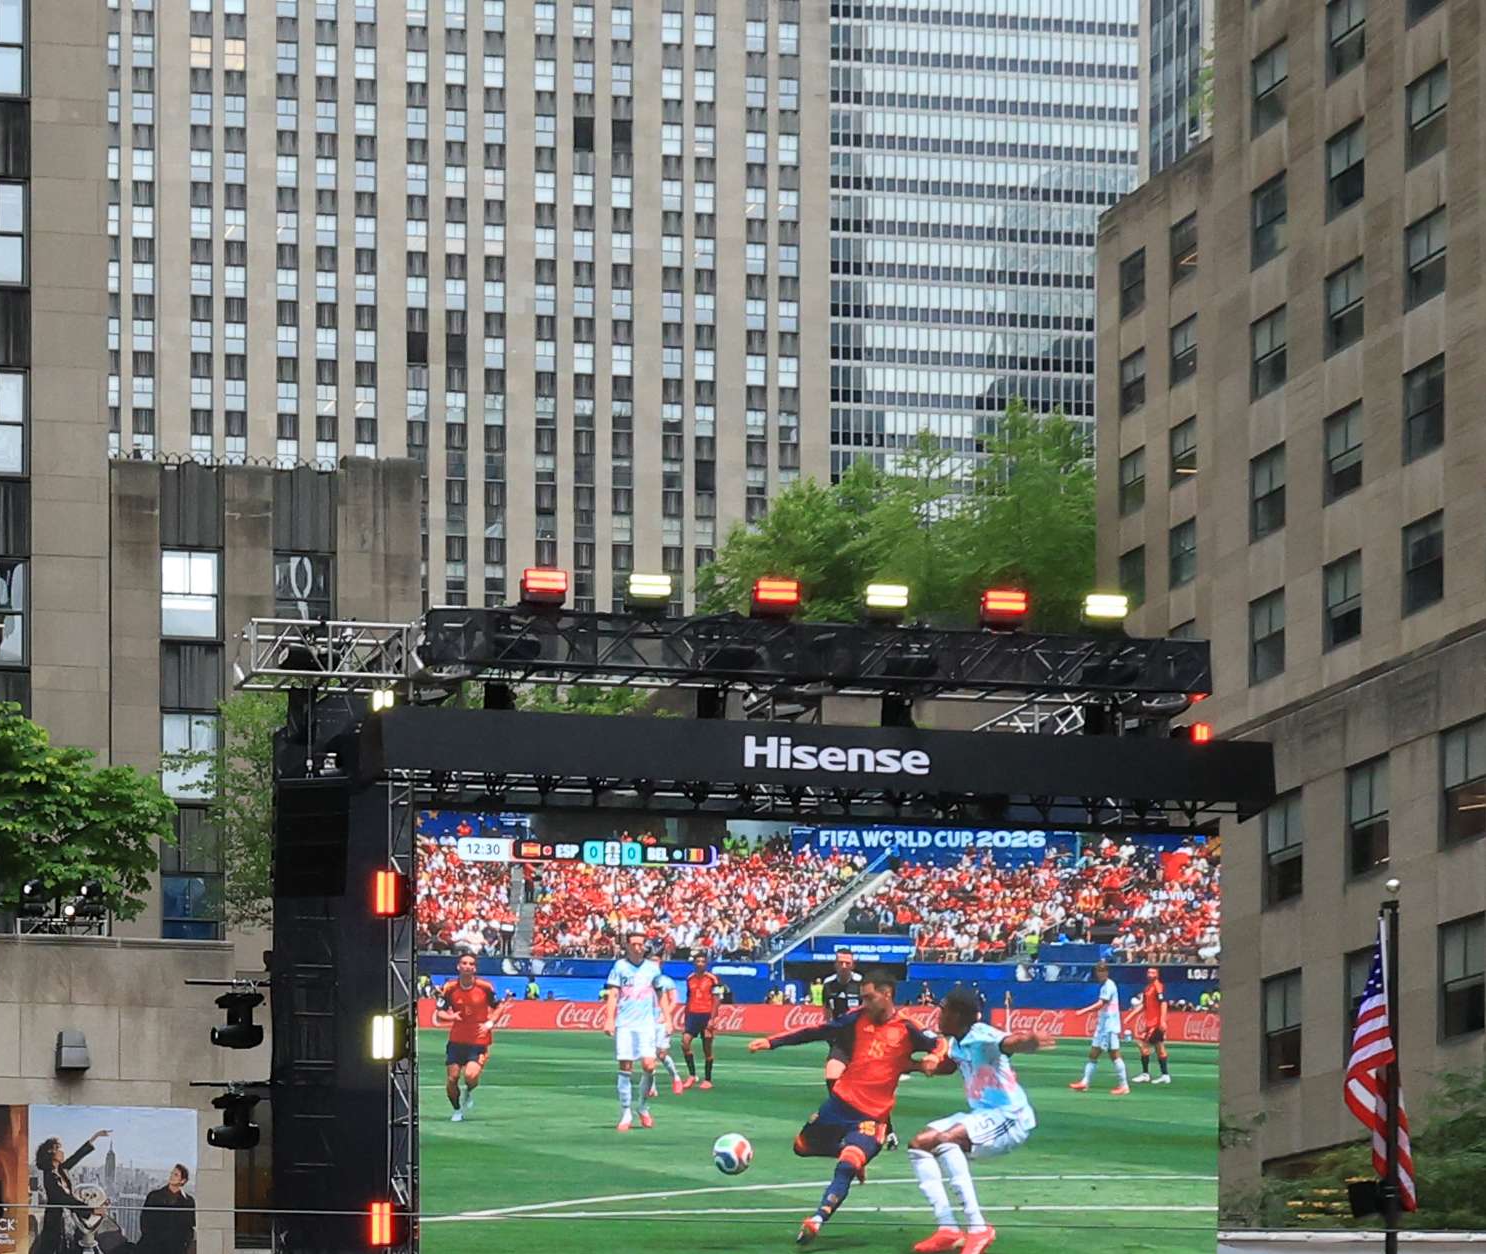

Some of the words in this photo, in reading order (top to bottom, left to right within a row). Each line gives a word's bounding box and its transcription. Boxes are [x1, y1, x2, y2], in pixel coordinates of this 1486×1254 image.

[743, 736, 930, 775] Hisense
[819, 831, 860, 848] FIFA
[864, 831, 931, 848] WORLD
[934, 831, 973, 848] CUP
[975, 830, 1047, 848] 2026
[466, 843, 501, 856] 12:30
[555, 844, 580, 858] ESP
[589, 846, 599, 859] 0
[627, 847, 637, 860] 0
[646, 847, 670, 862] BEL
